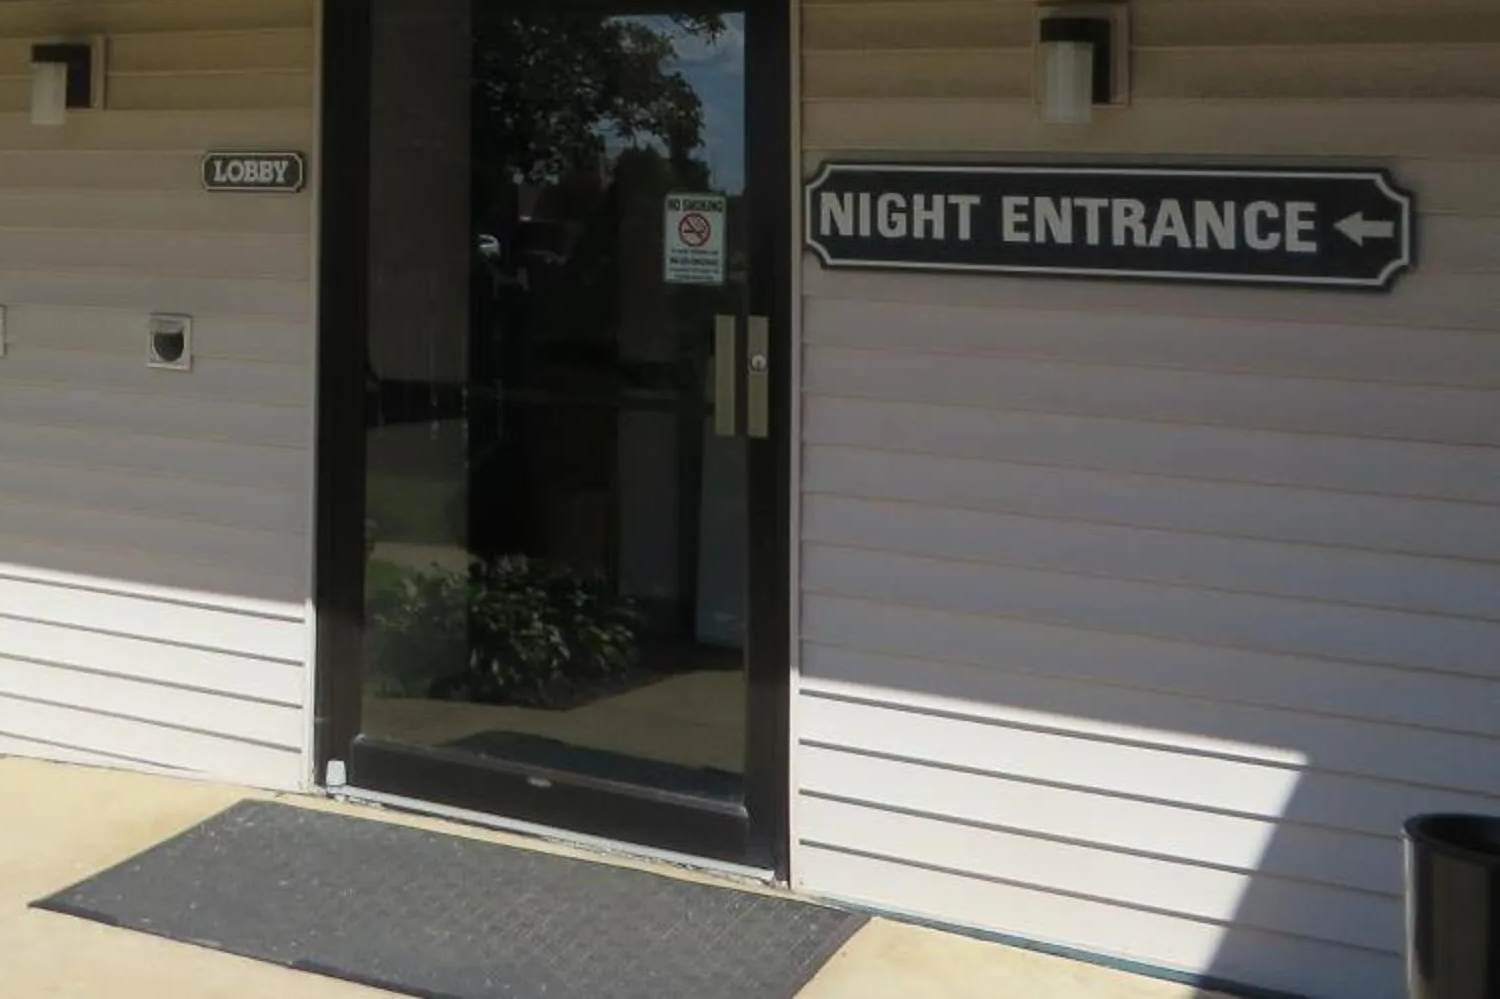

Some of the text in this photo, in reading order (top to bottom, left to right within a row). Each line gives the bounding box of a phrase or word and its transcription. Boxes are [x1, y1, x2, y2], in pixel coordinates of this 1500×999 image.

[213, 159, 289, 184] LOBBY
[667, 199, 681, 211] NO
[820, 192, 1319, 253] NIGHT ENTRANCE
